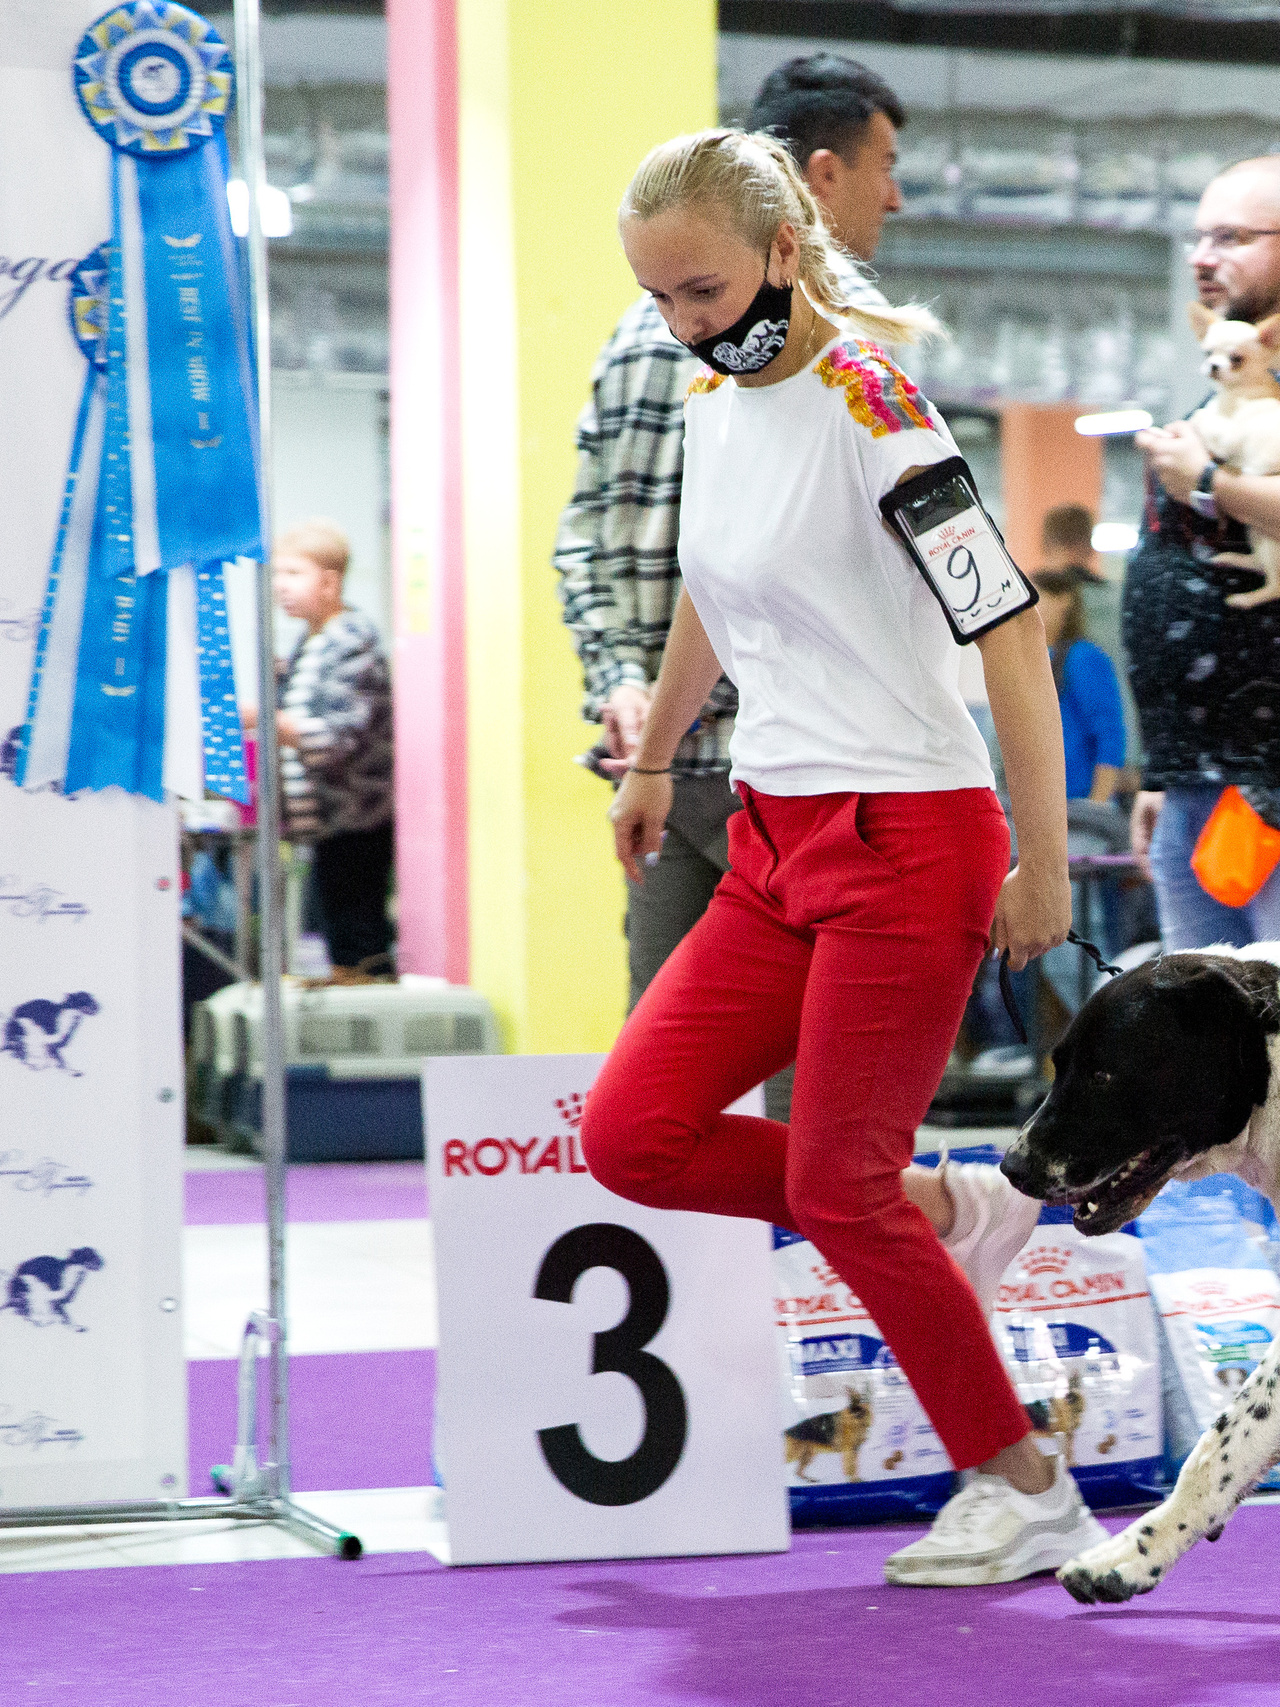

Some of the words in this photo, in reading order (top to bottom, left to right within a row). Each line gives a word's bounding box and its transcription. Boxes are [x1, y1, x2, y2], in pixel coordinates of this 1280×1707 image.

[928, 540, 952, 558] ROYAL
[951, 526, 976, 545] CANIN
[946, 544, 981, 613] 9
[443, 1136, 588, 1178] ROYAL
[533, 1222, 689, 1507] 3
